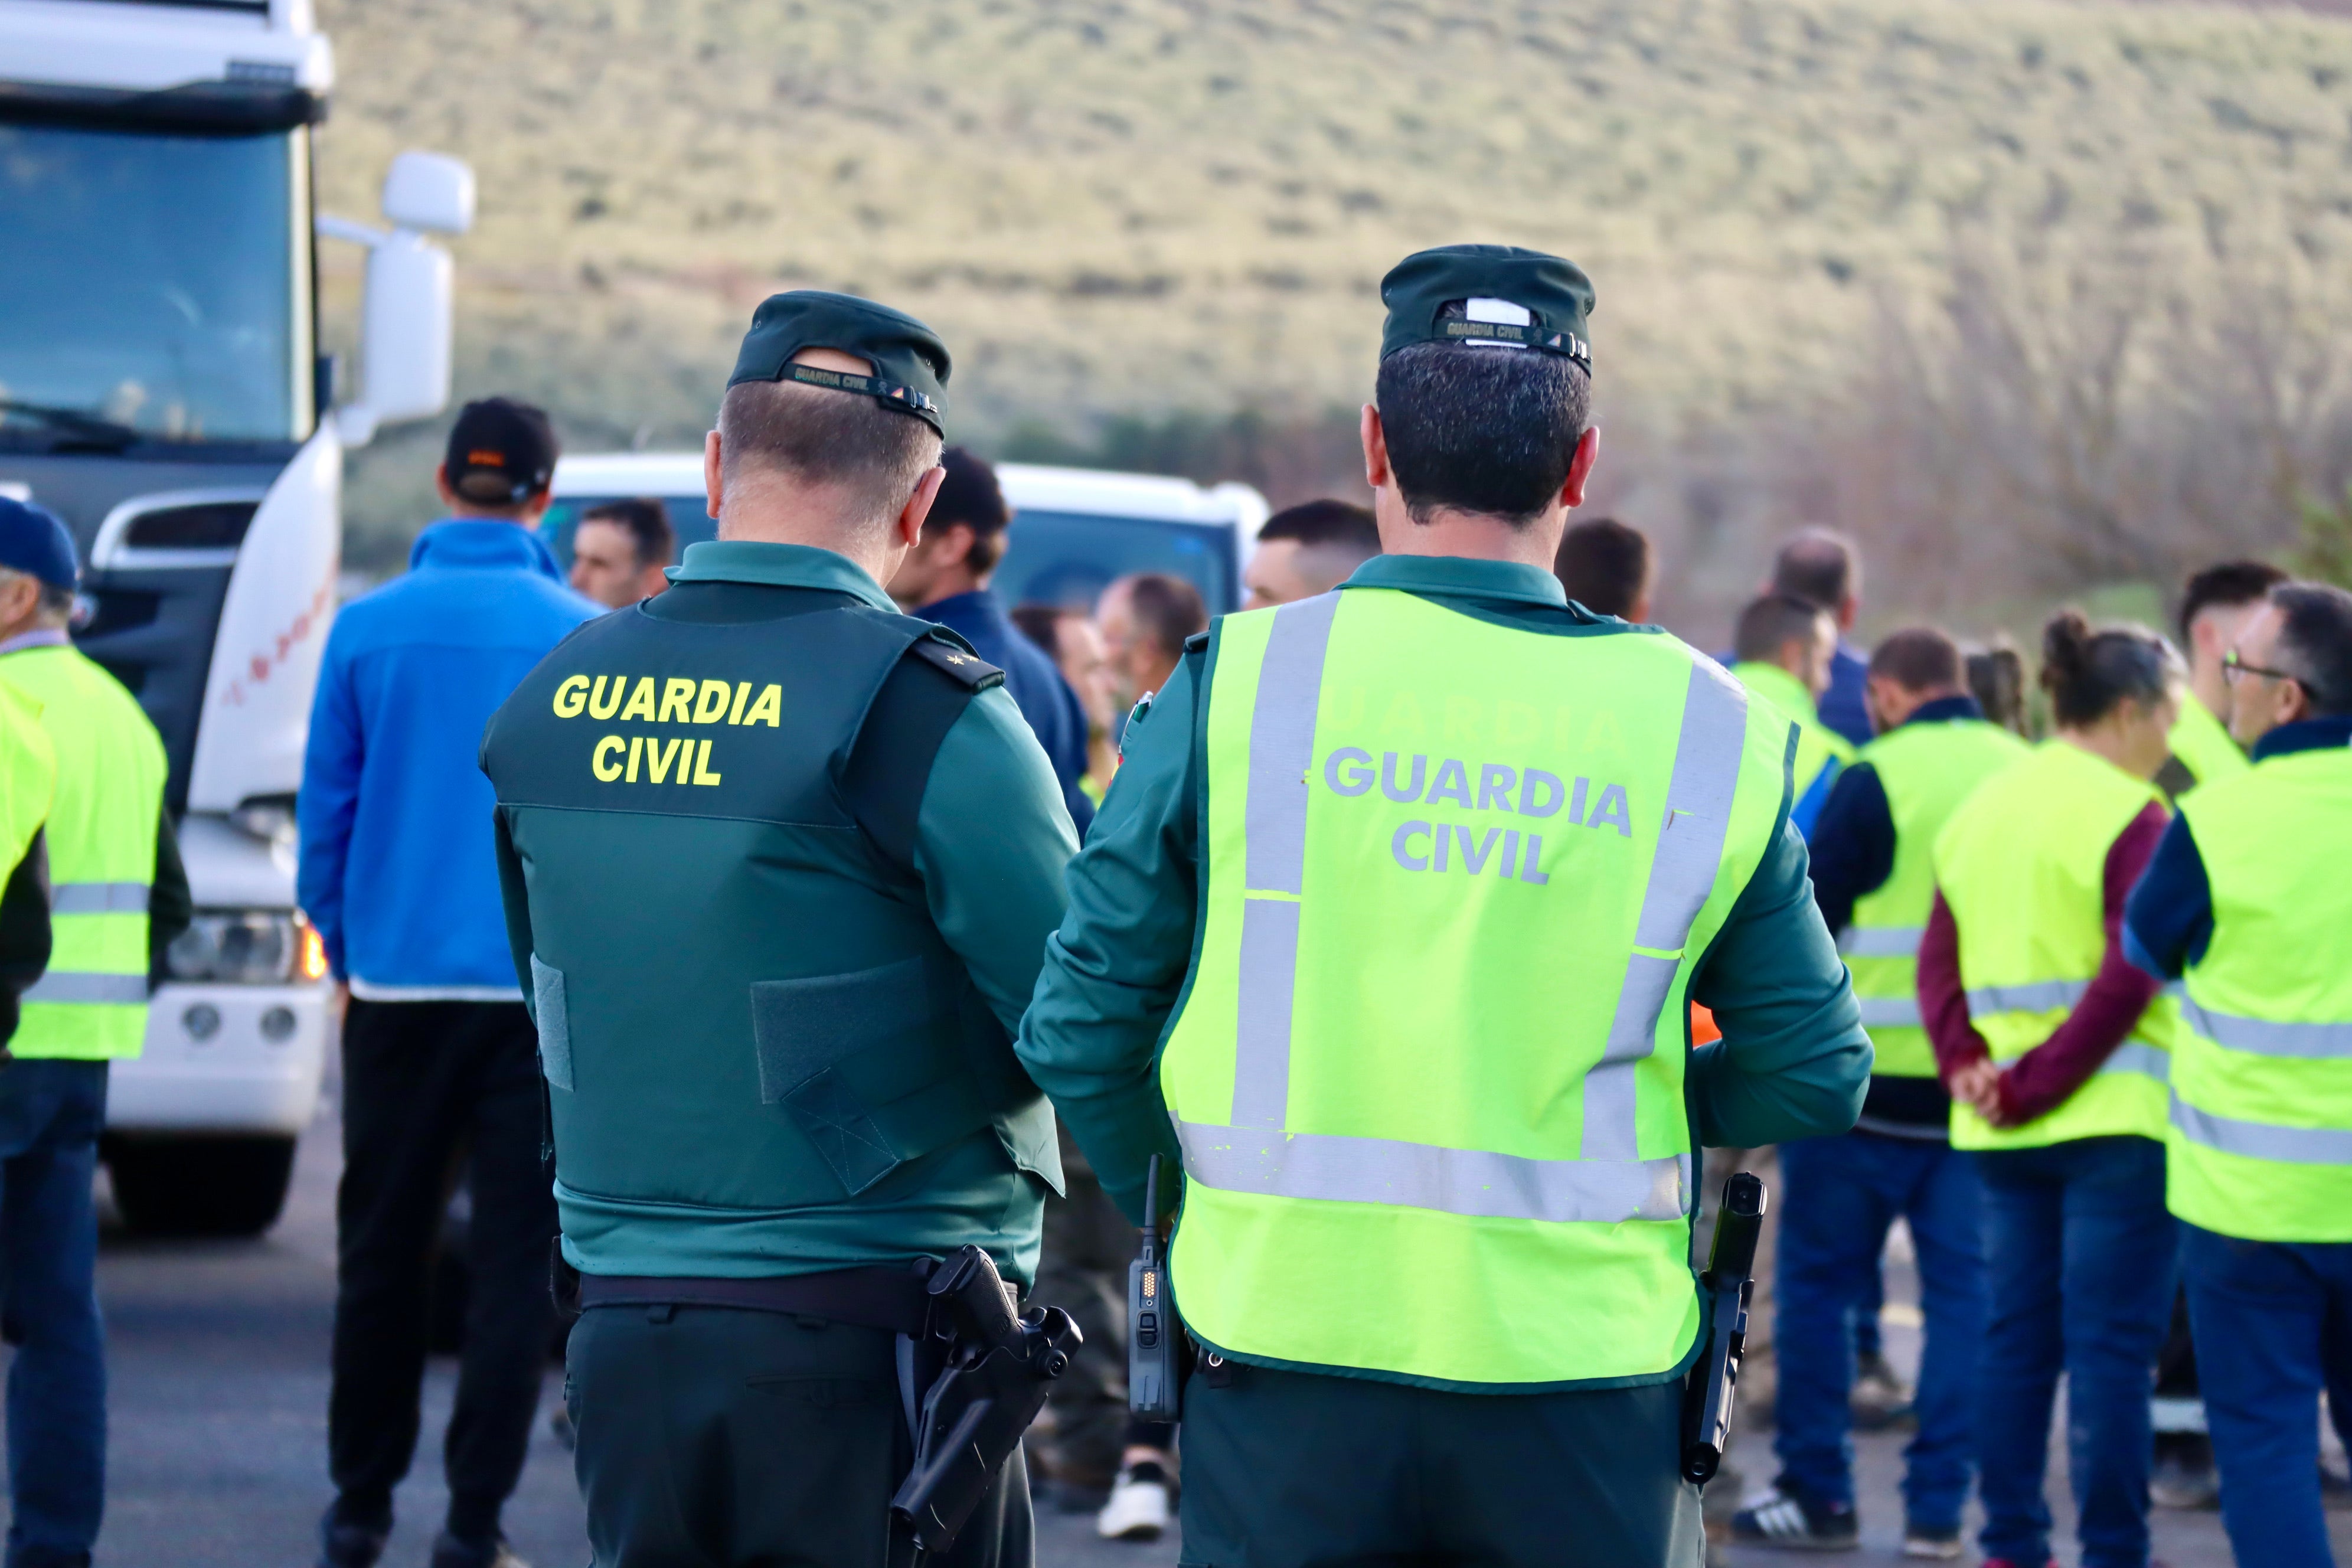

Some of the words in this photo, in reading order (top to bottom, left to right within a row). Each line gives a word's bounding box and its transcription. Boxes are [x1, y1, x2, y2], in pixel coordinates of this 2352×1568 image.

[1447, 322, 1494, 337] GUARDIA
[1497, 326, 1524, 339] CIVIL
[795, 368, 840, 387] GUARDIA
[842, 375, 870, 391] CIVIL
[553, 675, 781, 727] GUARDIA
[593, 736, 721, 785] CIVIL
[1323, 746, 1631, 837] GUARDIA
[1391, 819, 1548, 884] CIVIL
